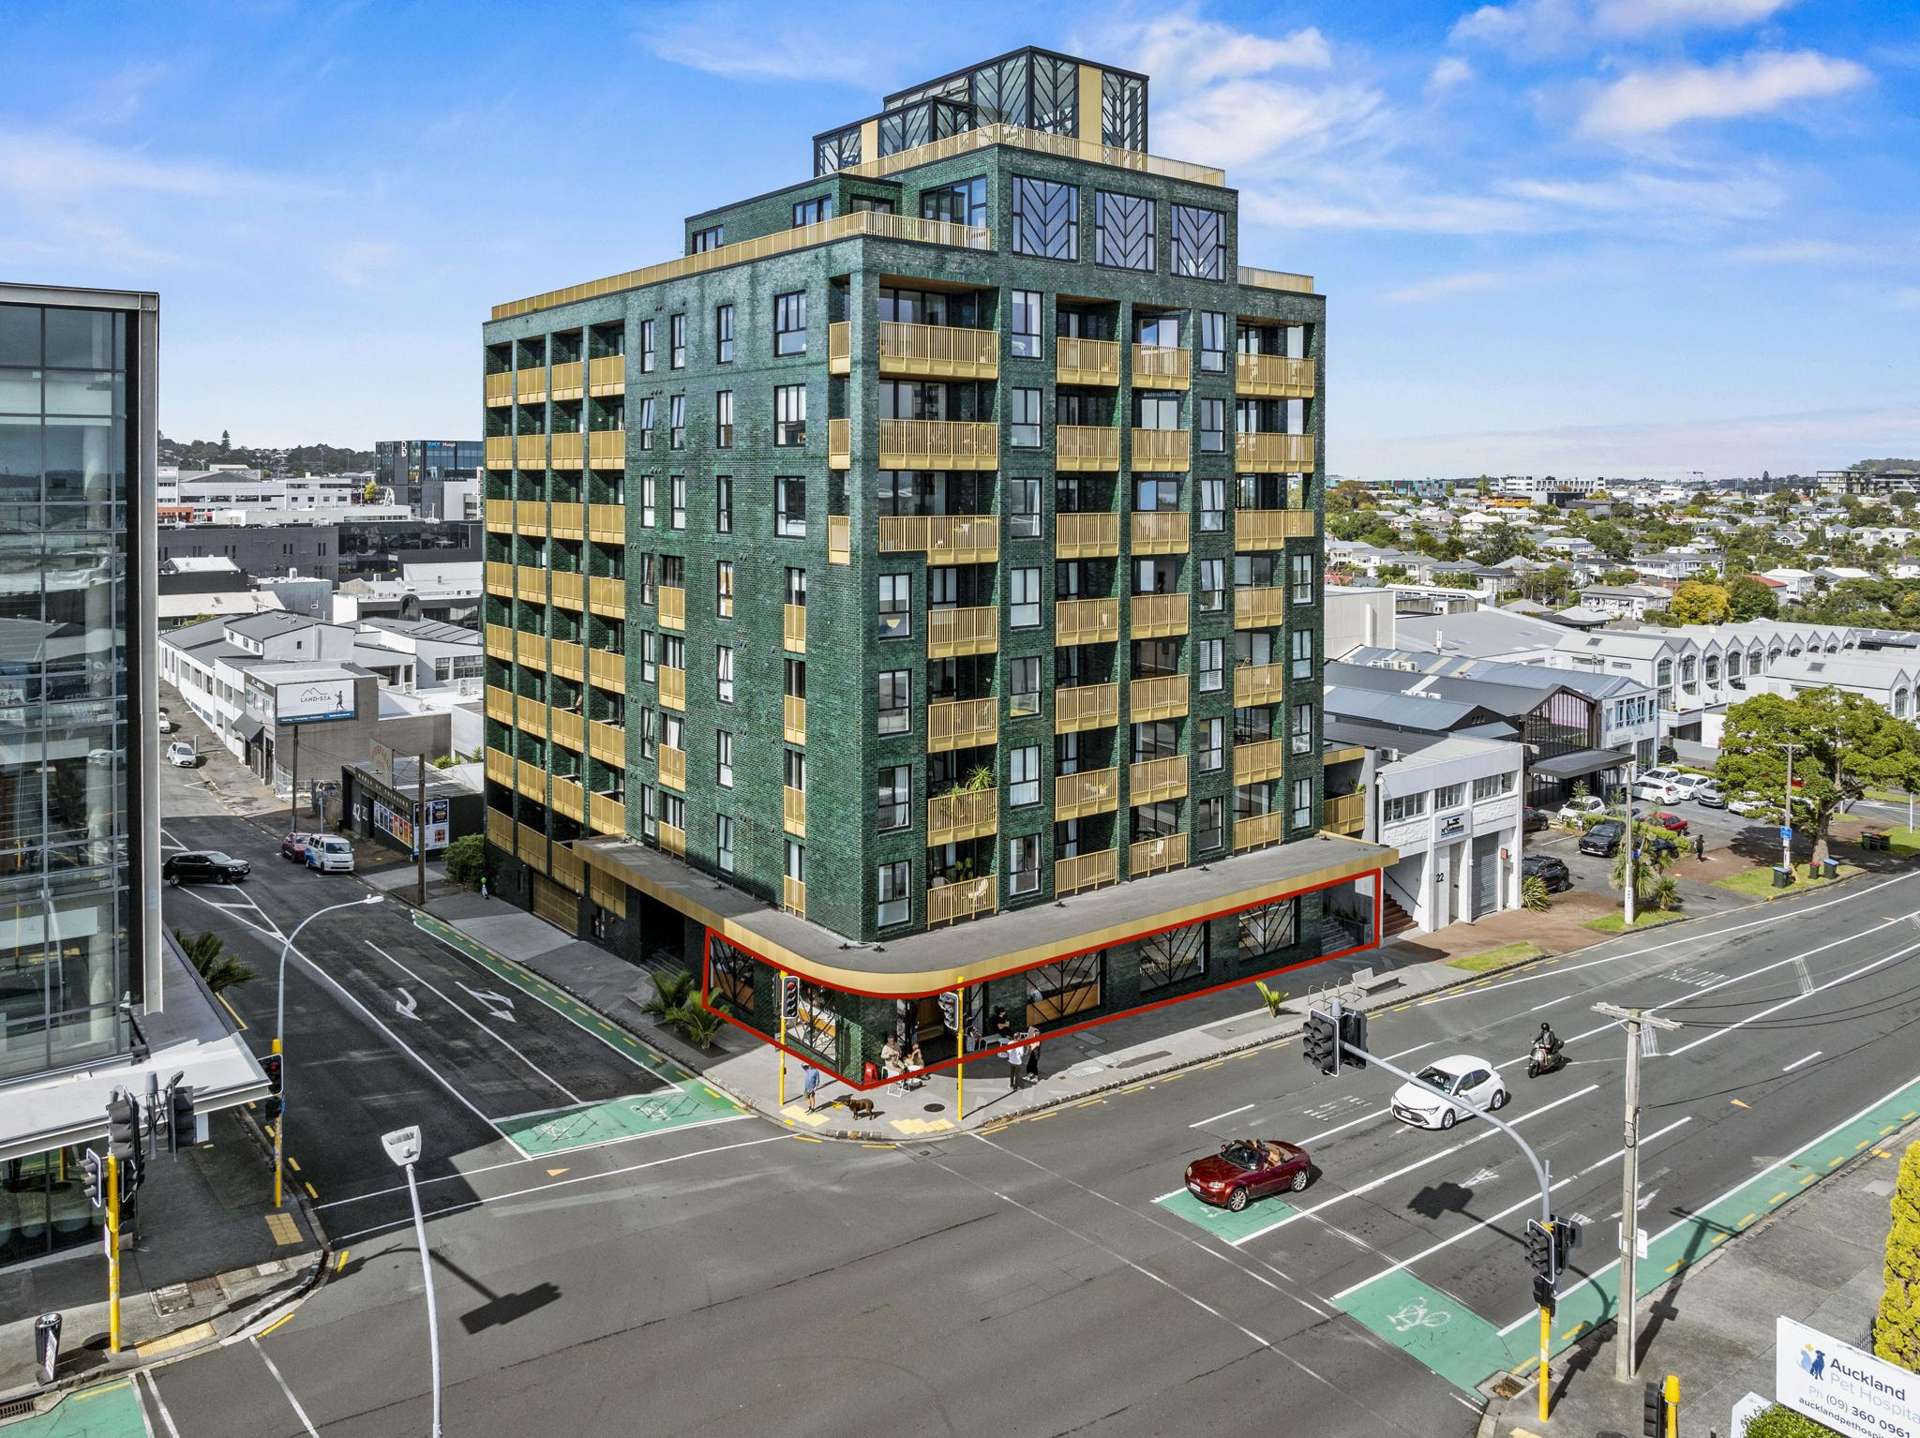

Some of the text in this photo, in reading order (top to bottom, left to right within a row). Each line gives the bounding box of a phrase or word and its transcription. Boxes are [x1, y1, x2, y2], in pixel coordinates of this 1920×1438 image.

[1436, 872, 1444, 883] 22
[1830, 1358, 1906, 1401] Auckland
[1830, 1372, 1854, 1394] Pet
[1826, 1394, 1849, 1413] (09)
[1851, 1406, 1876, 1425] 360
[1879, 1419, 1910, 1438] 0961
